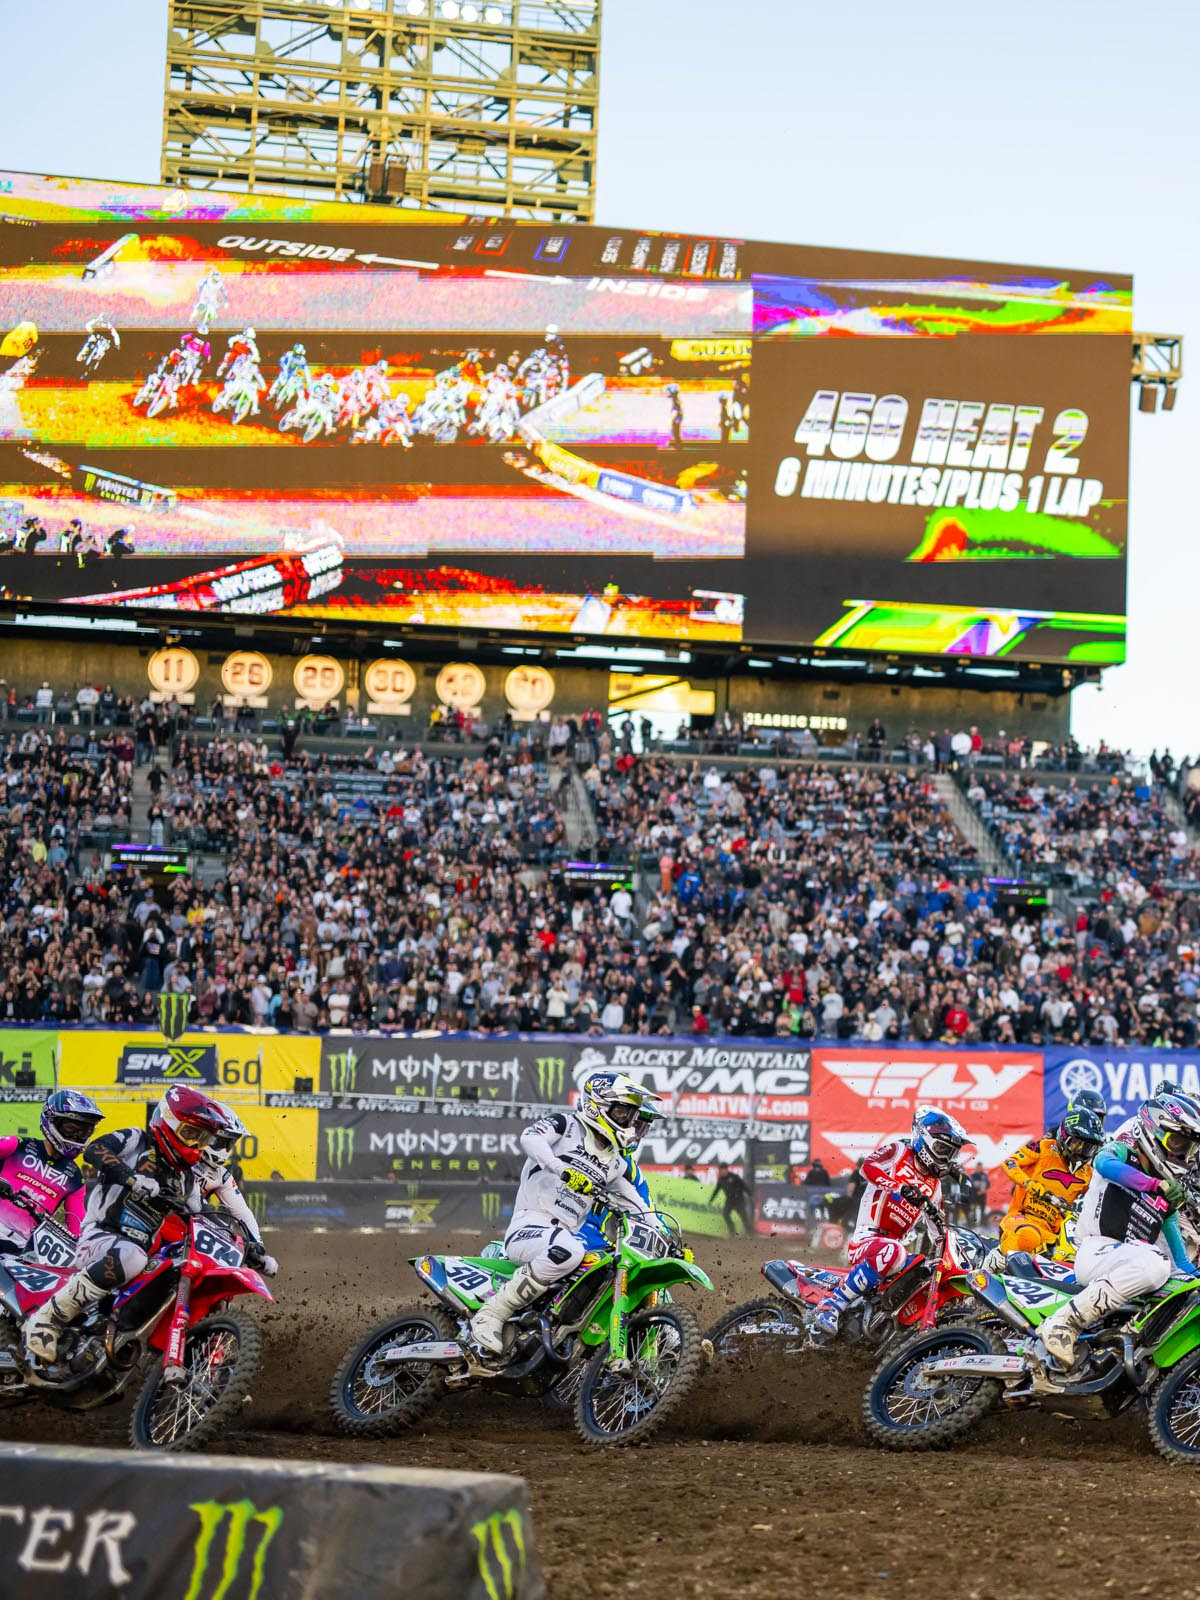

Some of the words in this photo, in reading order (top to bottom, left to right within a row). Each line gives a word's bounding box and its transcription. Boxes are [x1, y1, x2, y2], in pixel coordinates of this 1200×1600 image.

[217, 235, 355, 262] OUTSIDE
[586, 277, 710, 301] INSIDE
[794, 390, 908, 461] 450
[911, 398, 1044, 470] HEAT
[1043, 408, 1088, 474] 2
[774, 457, 801, 497] 6
[801, 459, 1023, 512] MINUTES/PLUS
[1026, 475, 1044, 513] 1
[1043, 476, 1103, 517] LAP
[162, 658, 184, 683] 11
[743, 712, 807, 729] CLASSIC
[371, 1055, 521, 1082] MONSTER
[613, 1045, 686, 1066] ROCKY
[687, 1047, 811, 1069] MOUNTAIN
[395, 1086, 499, 1098] ENERY
[583, 1103, 599, 1117] Arai
[369, 1128, 521, 1157] MONSTER
[392, 1159, 497, 1172] ENERGY
[887, 1201, 913, 1224] HONDA
[38, 1233, 76, 1268] 667
[194, 1228, 242, 1267] 874
[625, 1224, 670, 1258] 519
[447, 1261, 490, 1291] 519
